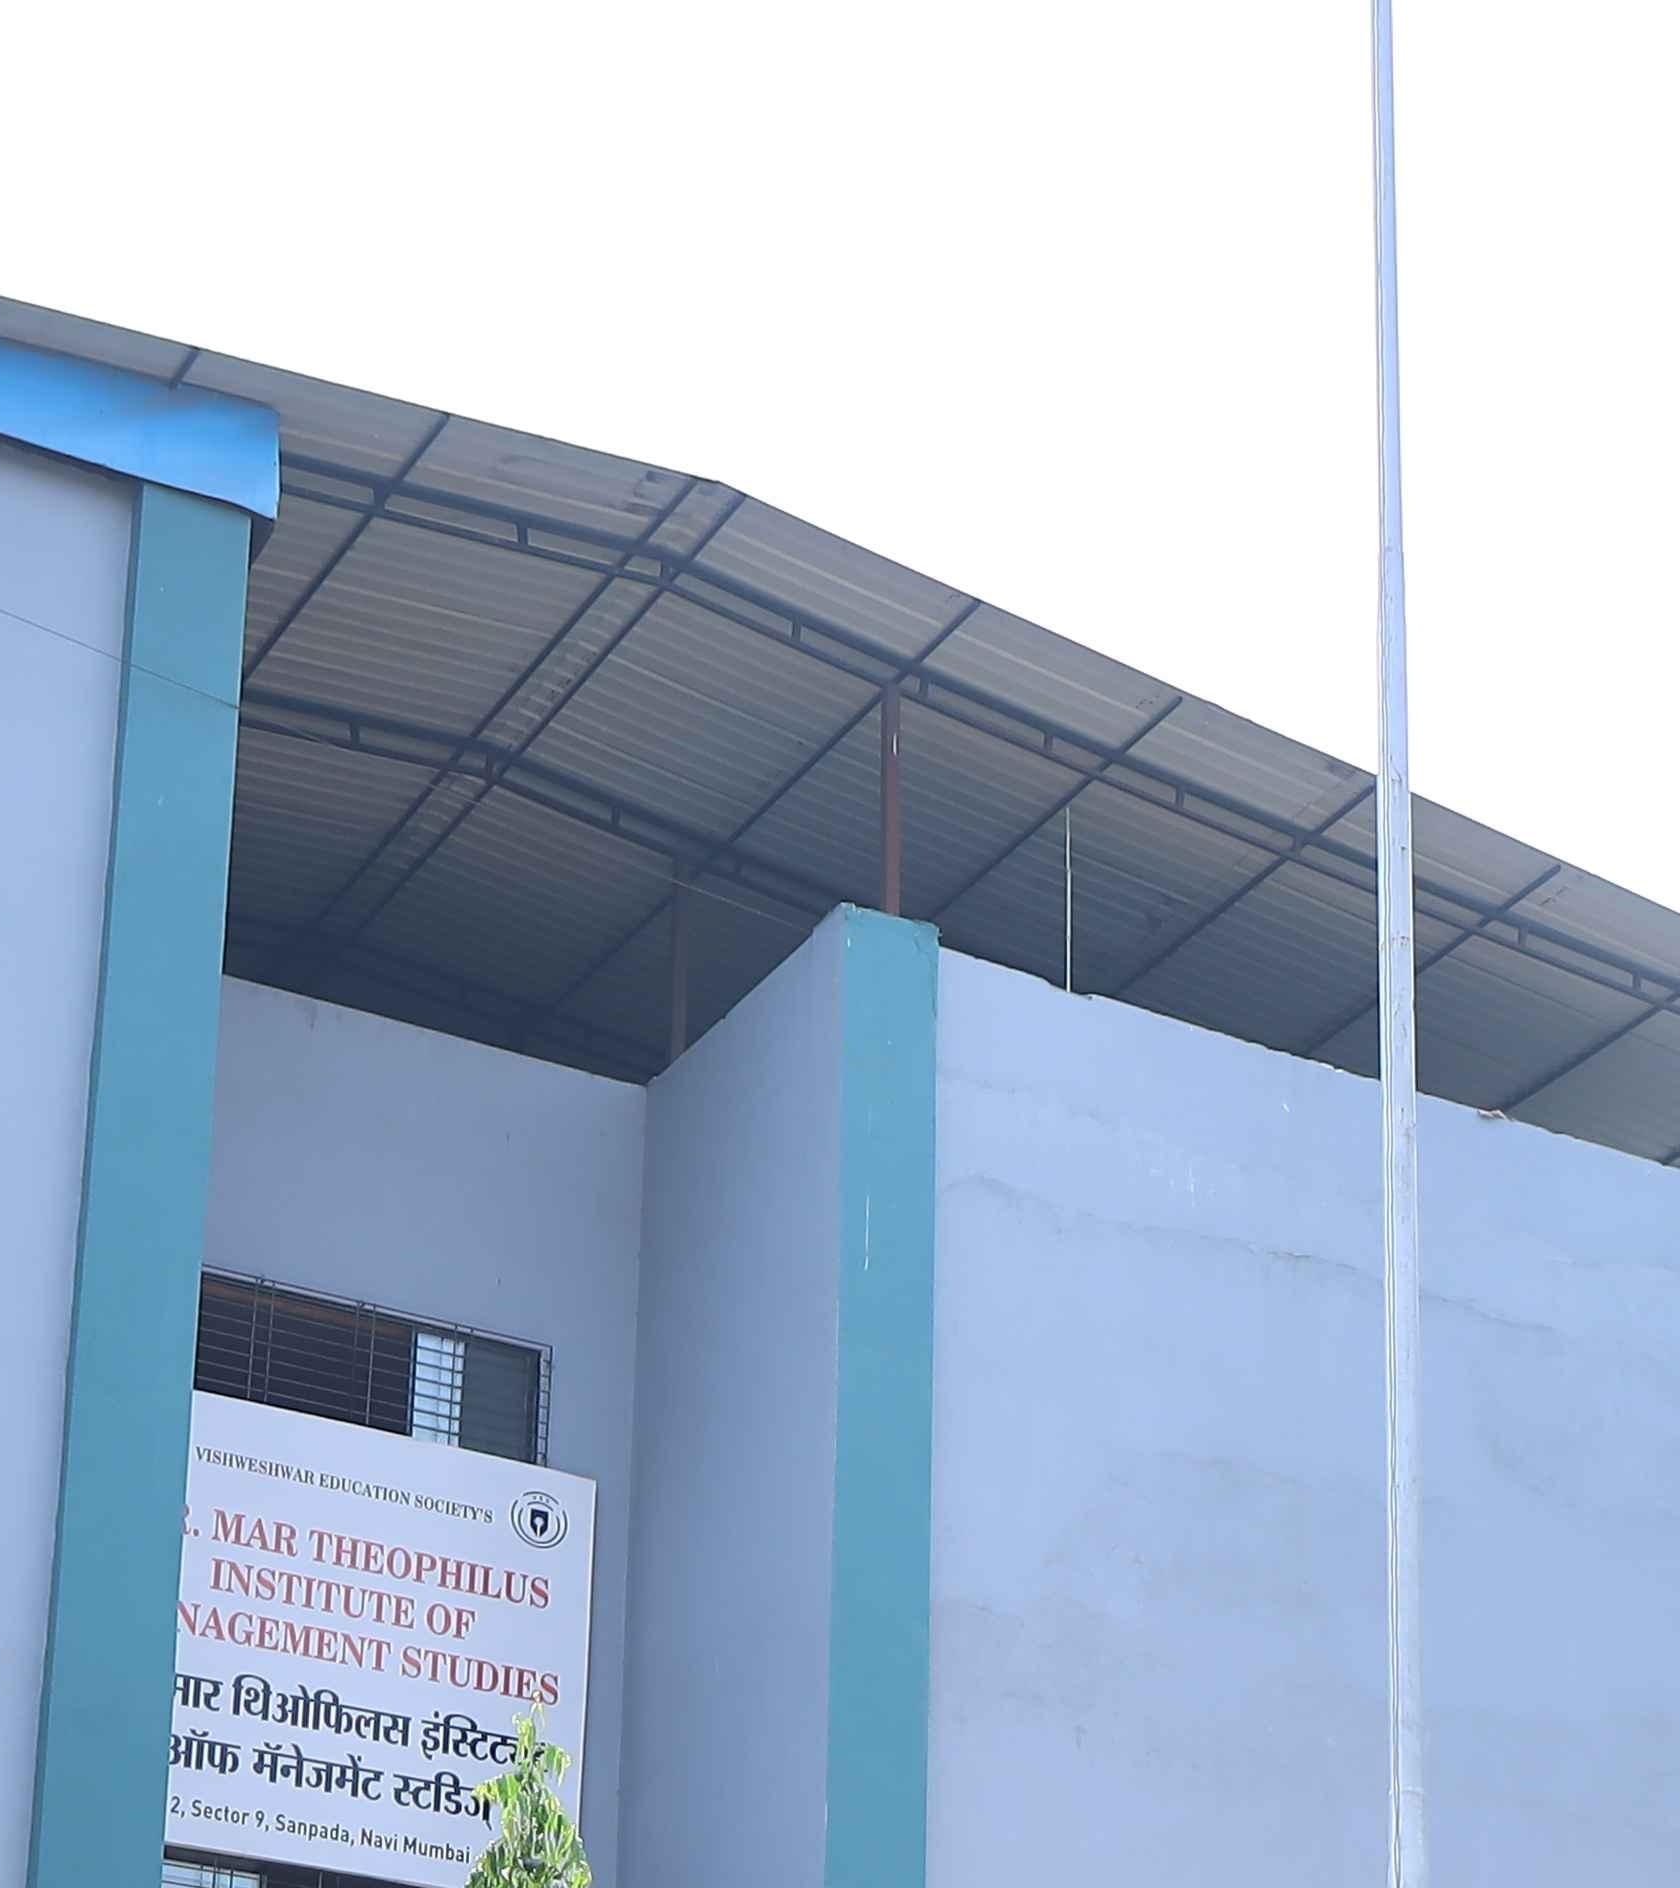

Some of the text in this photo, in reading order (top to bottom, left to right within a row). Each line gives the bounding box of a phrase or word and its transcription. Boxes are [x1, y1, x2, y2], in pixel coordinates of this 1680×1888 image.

[195, 1446, 493, 1524] VISHWESHWAR EDUCATION SOCIETY'S
[212, 1508, 297, 1557] MAR
[309, 1528, 550, 1609] THEOPHILUS
[210, 1558, 477, 1641] INSTITUTE OF
[400, 1647, 560, 1706] STUDIES
[170, 1796, 470, 1866] 2, Sector 9, Sanpada, Navi Mumbai
